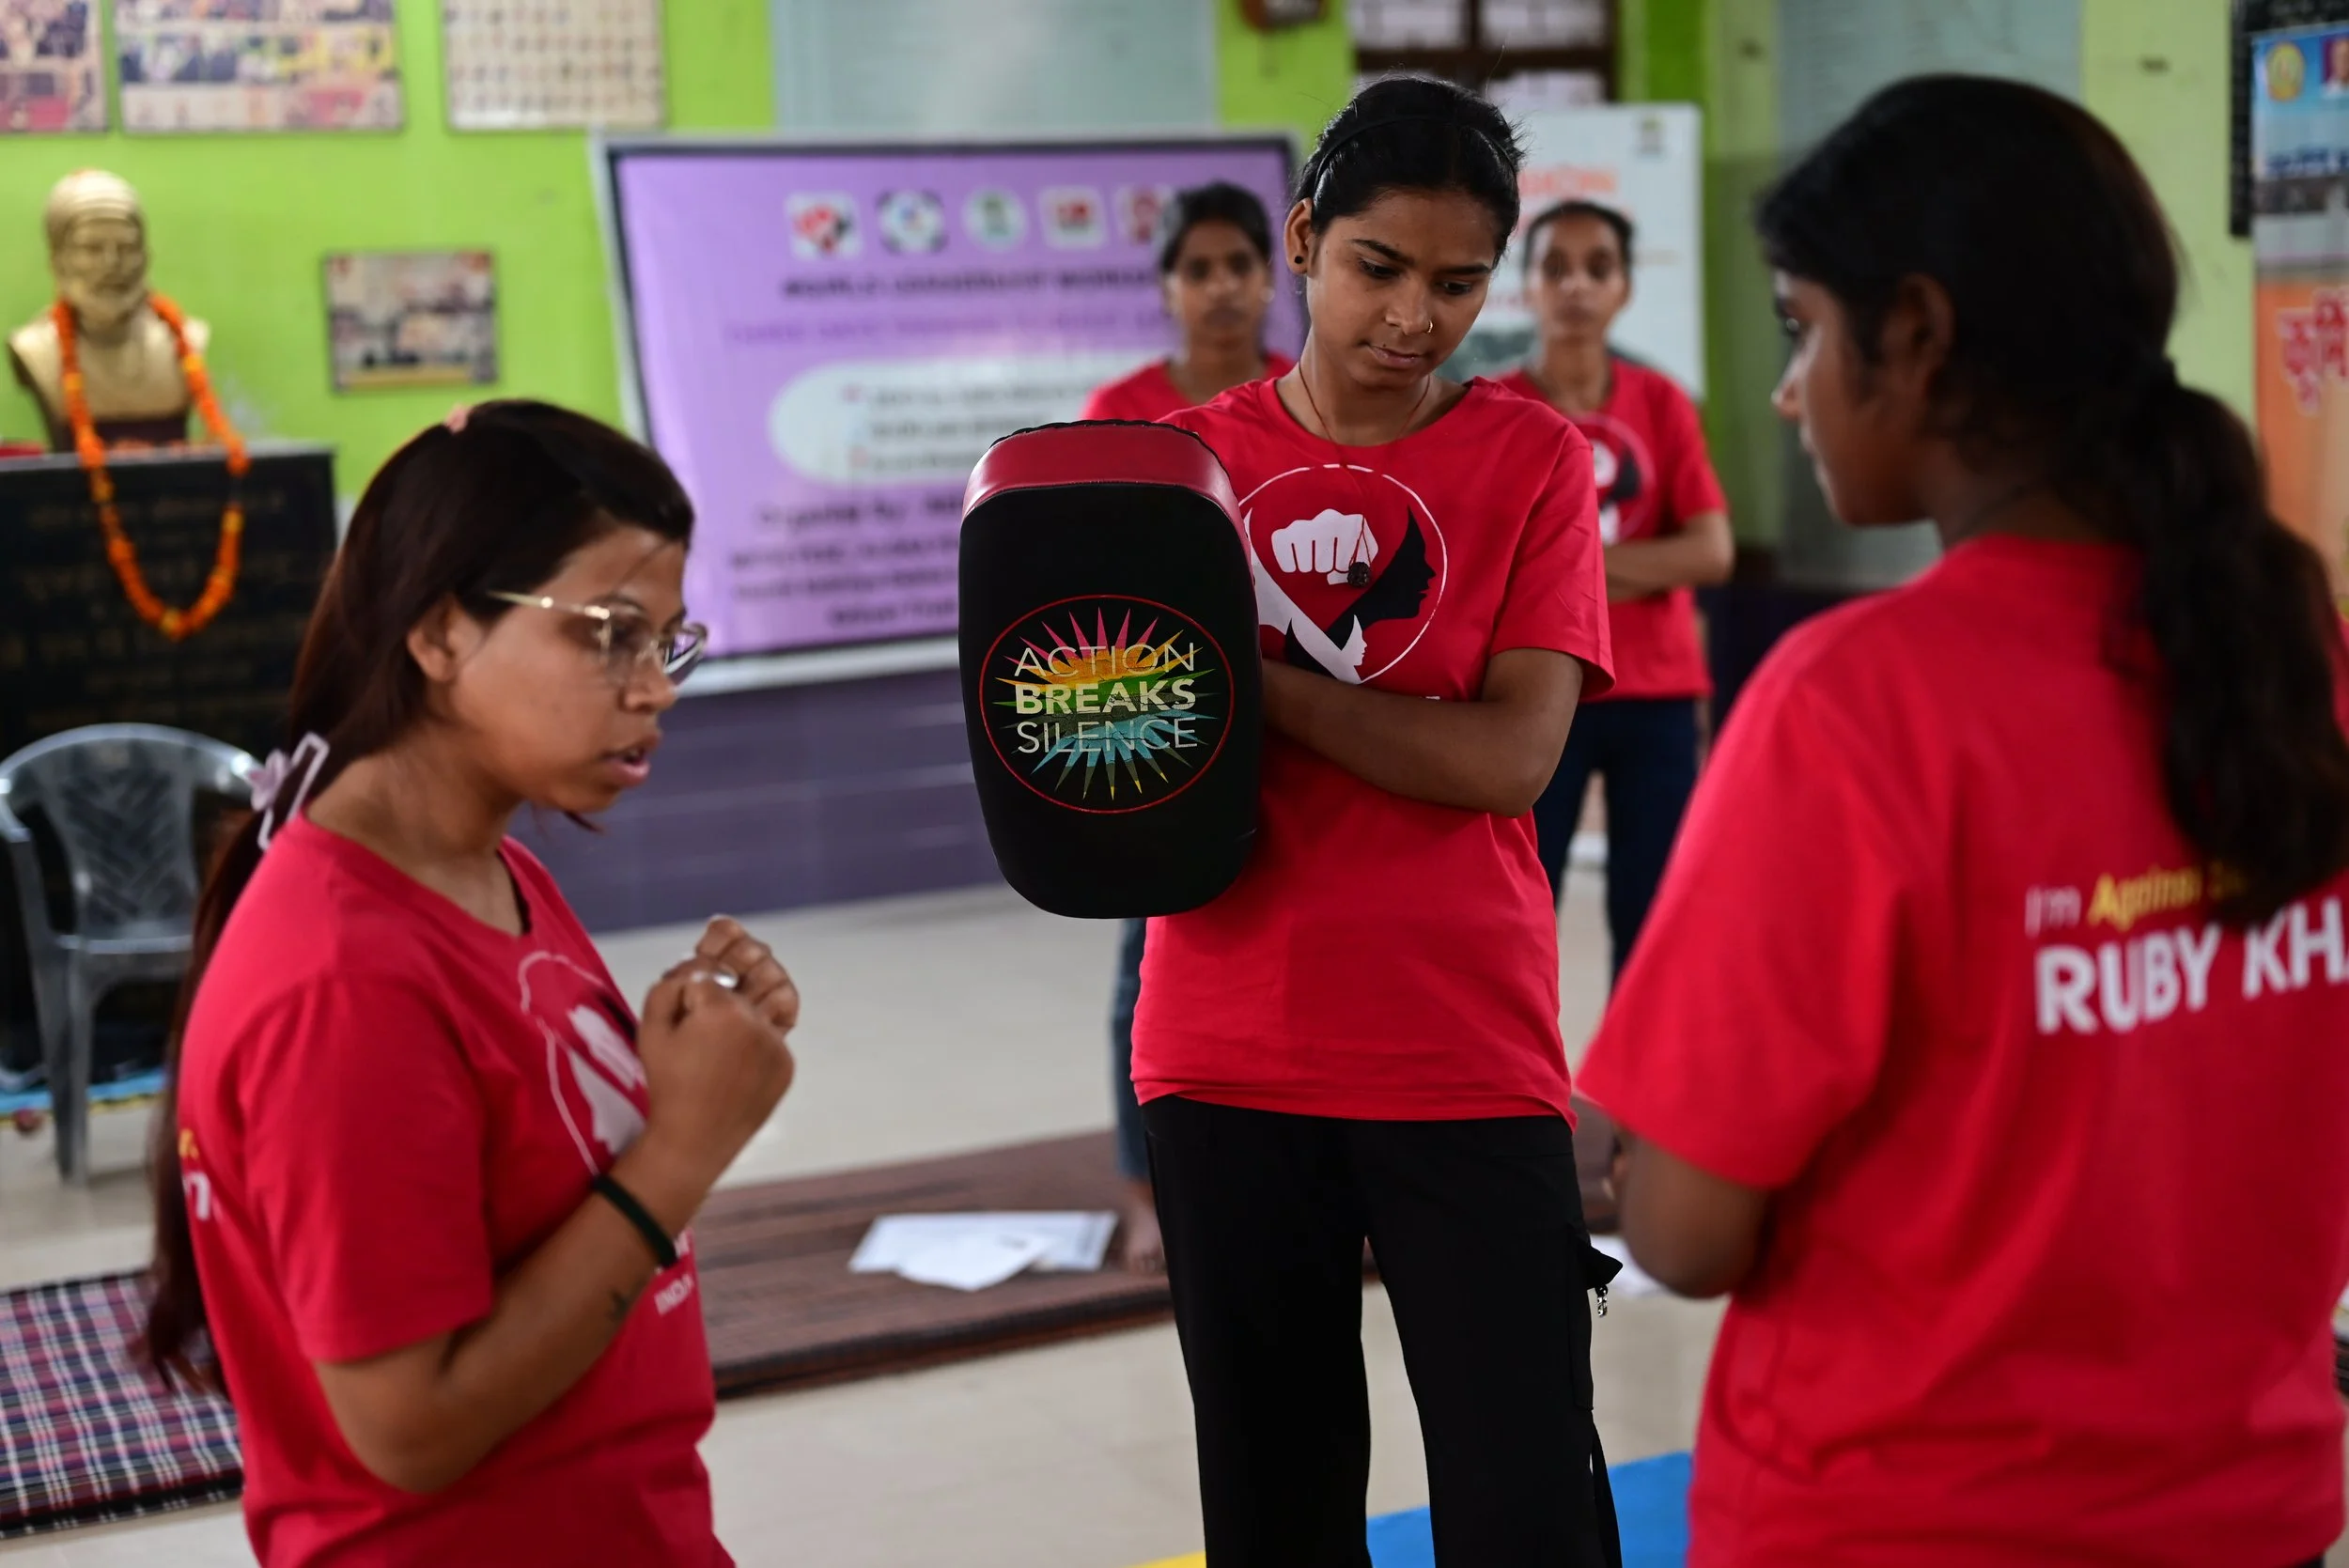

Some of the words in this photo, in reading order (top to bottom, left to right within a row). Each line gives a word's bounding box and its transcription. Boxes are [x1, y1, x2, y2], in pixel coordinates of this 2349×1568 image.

[1014, 643, 1195, 676] ACTION
[1015, 678, 1197, 714] BREAKS
[1017, 717, 1198, 753] SILENCE
[2035, 924, 2220, 1032] RUBY
[2241, 896, 2349, 999] KH
